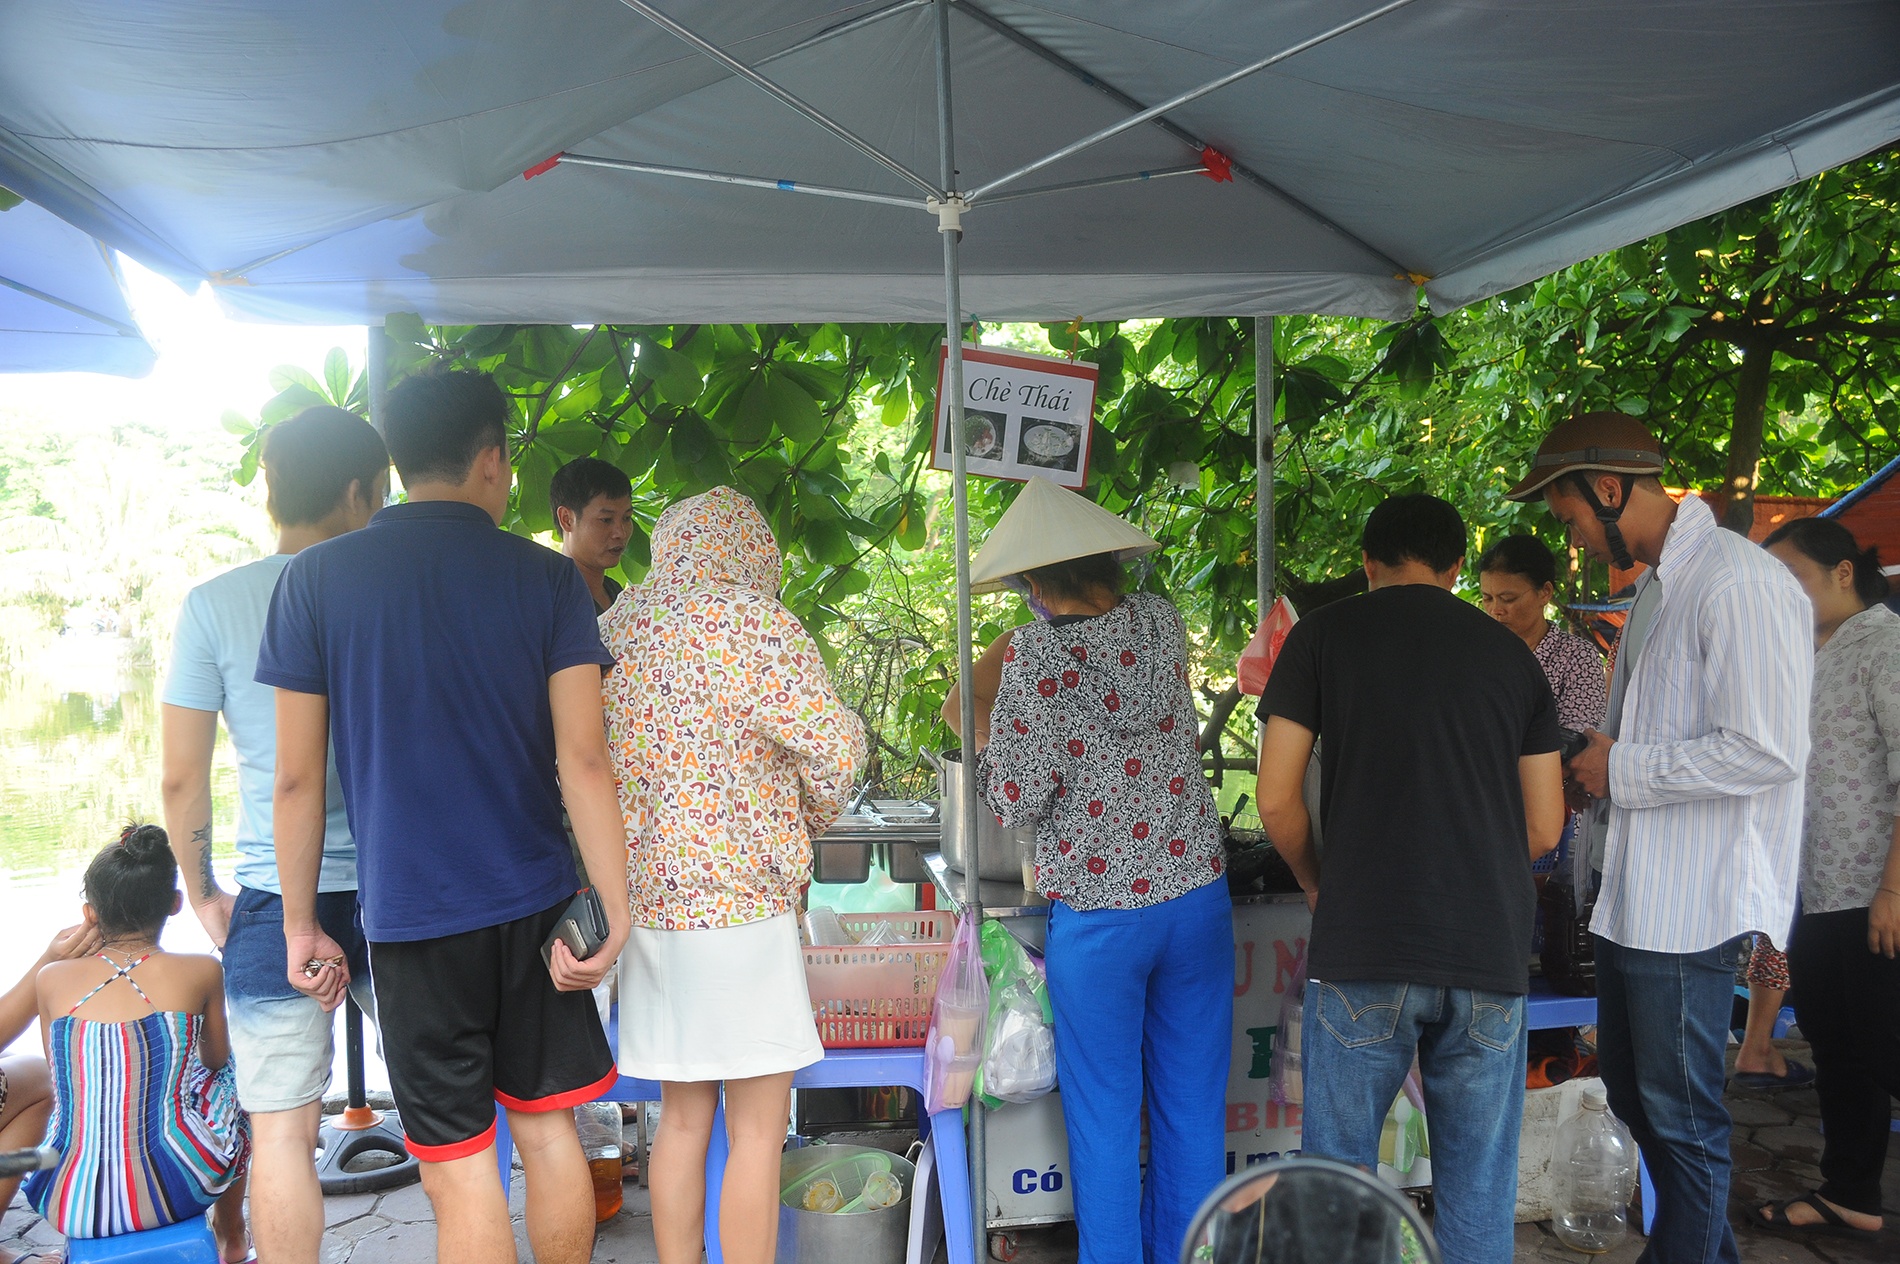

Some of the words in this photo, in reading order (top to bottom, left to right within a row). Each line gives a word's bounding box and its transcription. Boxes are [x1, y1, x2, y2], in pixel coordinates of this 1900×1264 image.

[968, 377, 1012, 402] Chè
[1018, 384, 1073, 412] Thái
[1012, 1163, 1063, 1195] Có
